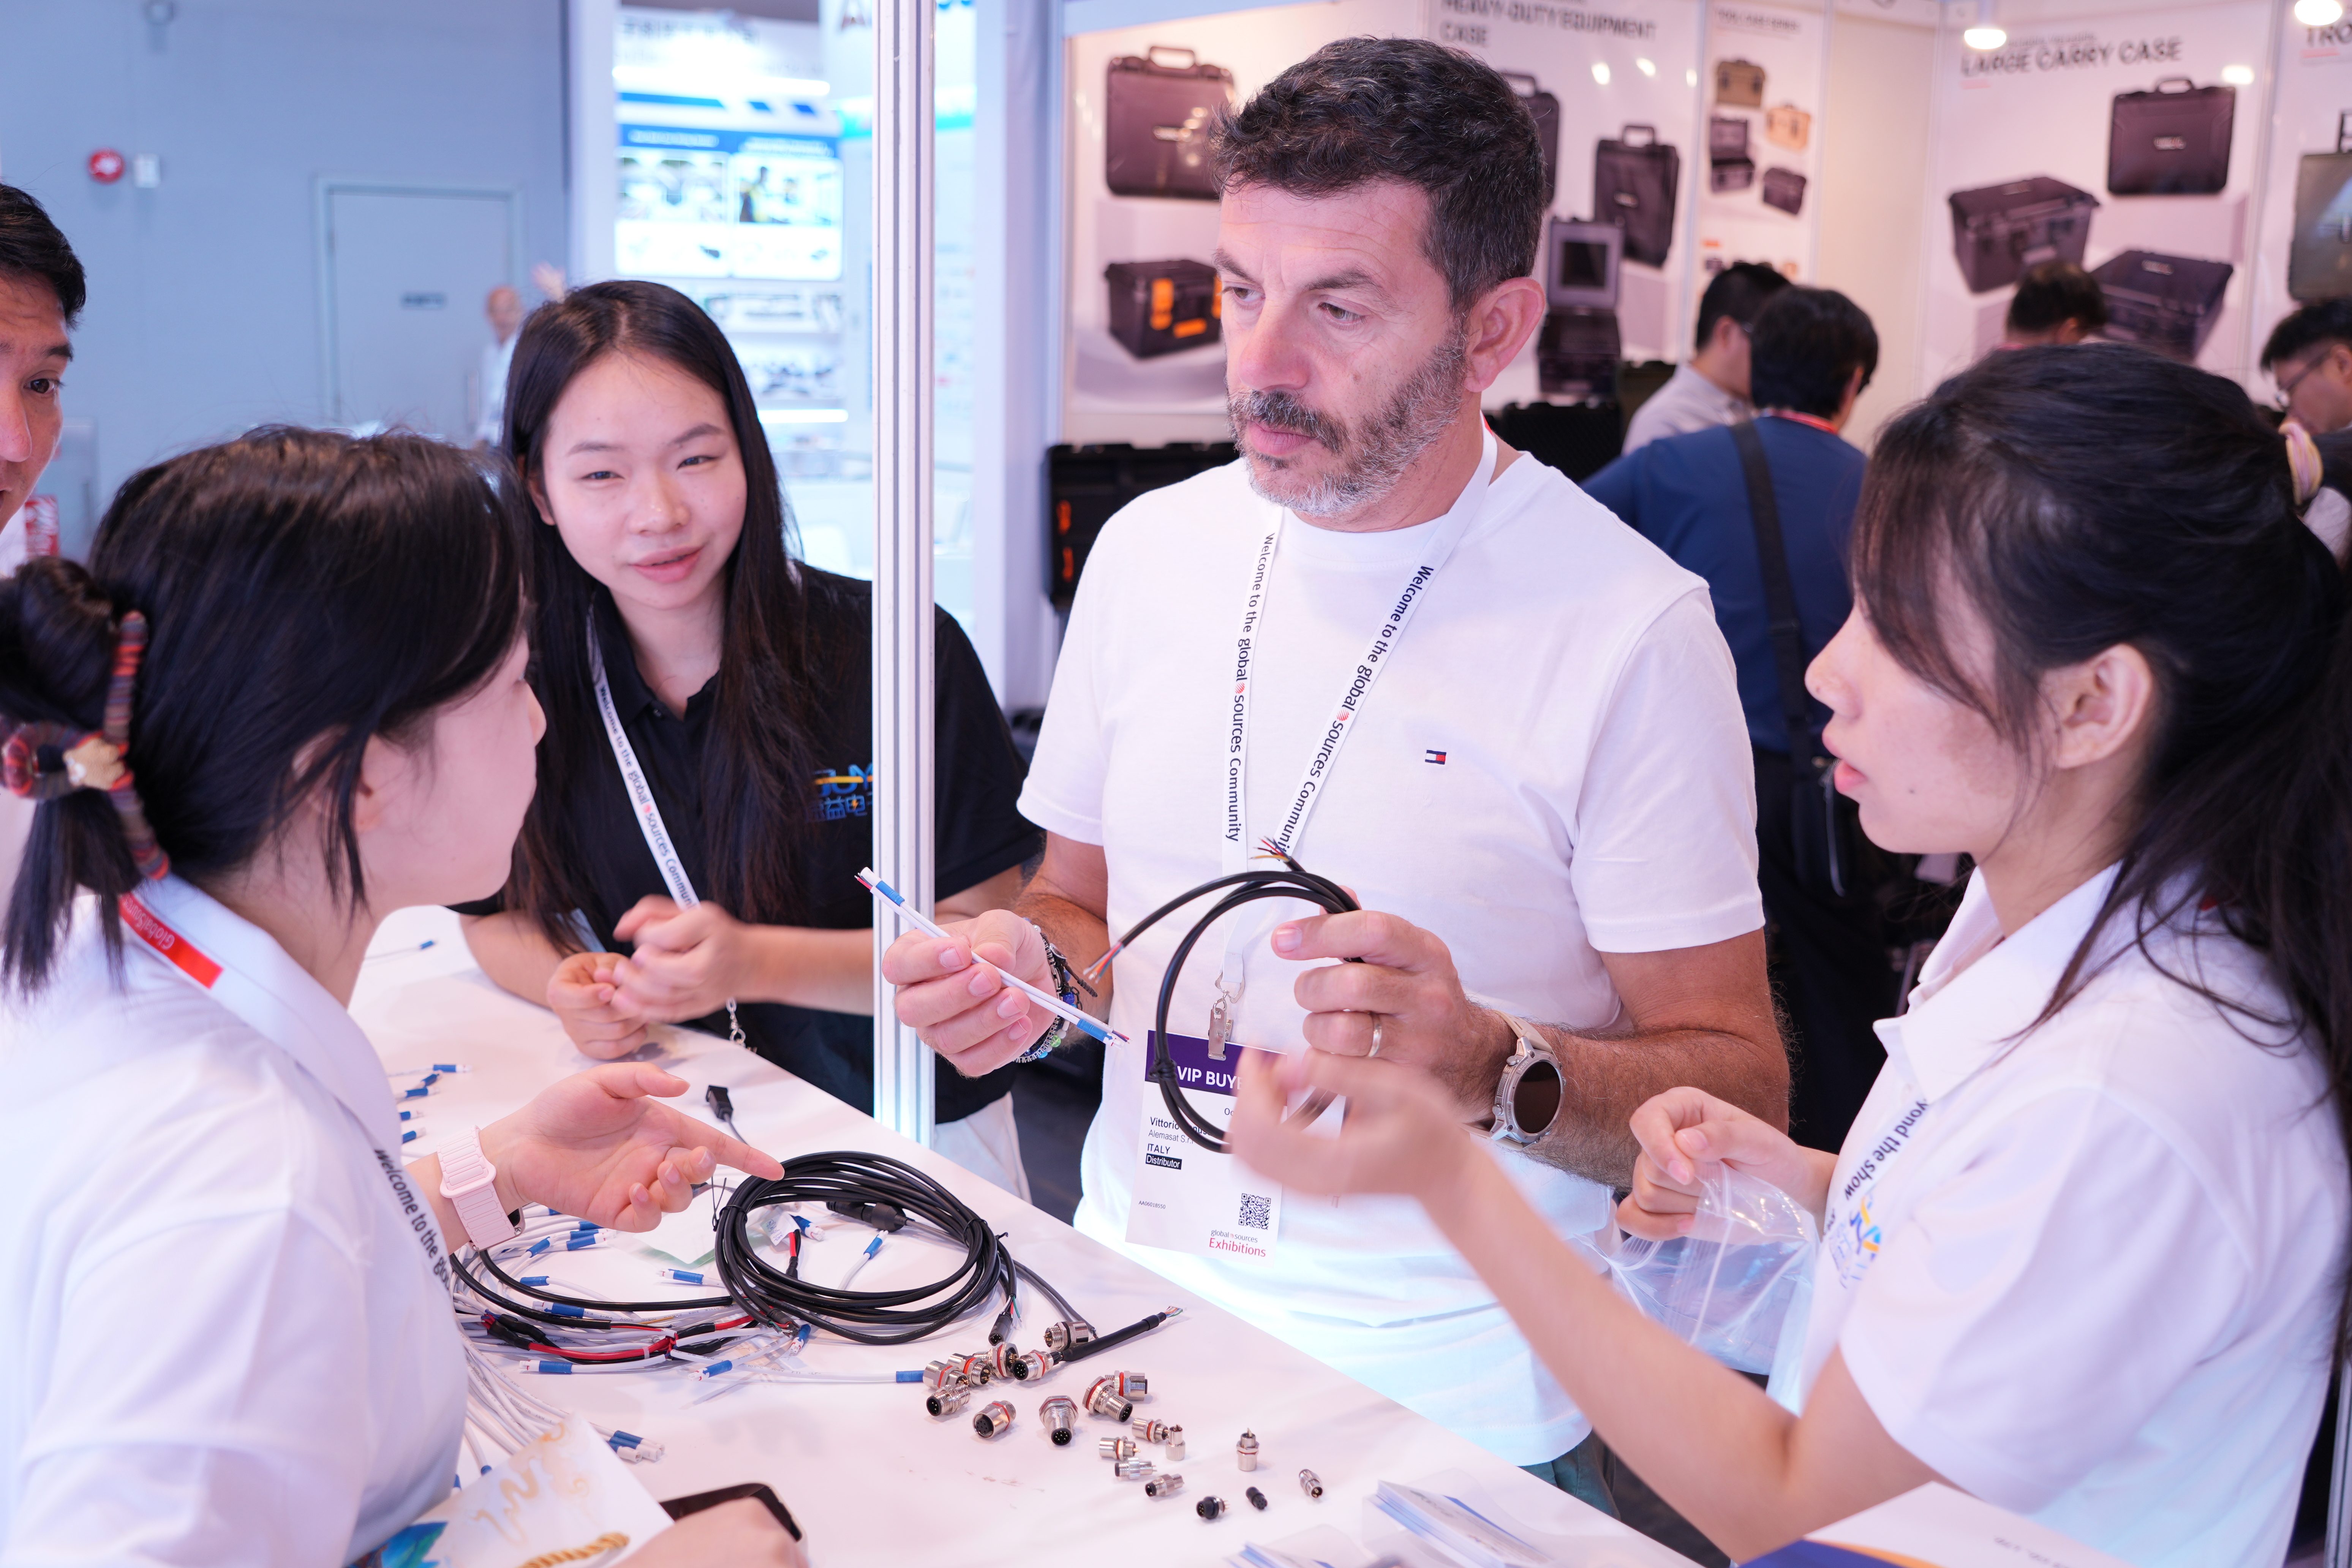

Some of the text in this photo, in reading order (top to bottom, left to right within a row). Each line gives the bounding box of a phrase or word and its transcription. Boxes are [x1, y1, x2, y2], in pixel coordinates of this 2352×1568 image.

[1441, 18, 1488, 46] CASE
[1560, 8, 1657, 40] EQUIPMENT
[2303, 22, 2352, 48] TRO
[1961, 51, 2032, 77] LARGE
[2035, 43, 2112, 71] CARRY
[2119, 35, 2184, 65] CASE
[1391, 566, 1434, 622] Welcome
[1381, 624, 1397, 638] to
[1367, 640, 1388, 662] the
[1225, 533, 1276, 842] Welcome to the global sources Community
[1342, 665, 1372, 711] global
[1310, 720, 1344, 778] sources
[600, 686, 697, 909] Welcome to the global sources Communi
[1177, 1065, 1202, 1083] VIP
[1148, 1129, 1179, 1142] Alemasat
[1150, 1116, 1179, 1130] Vittorio
[1146, 1154, 1181, 1168] Distributor
[1147, 1143, 1170, 1154] ITALY
[1844, 1097, 1929, 1201] yond the show
[374, 1148, 418, 1215] Welcome
[411, 1213, 427, 1232] to
[420, 1229, 438, 1258] the
[1209, 1237, 1266, 1258] Exhibitions
[1211, 1229, 1258, 1243] global sources
